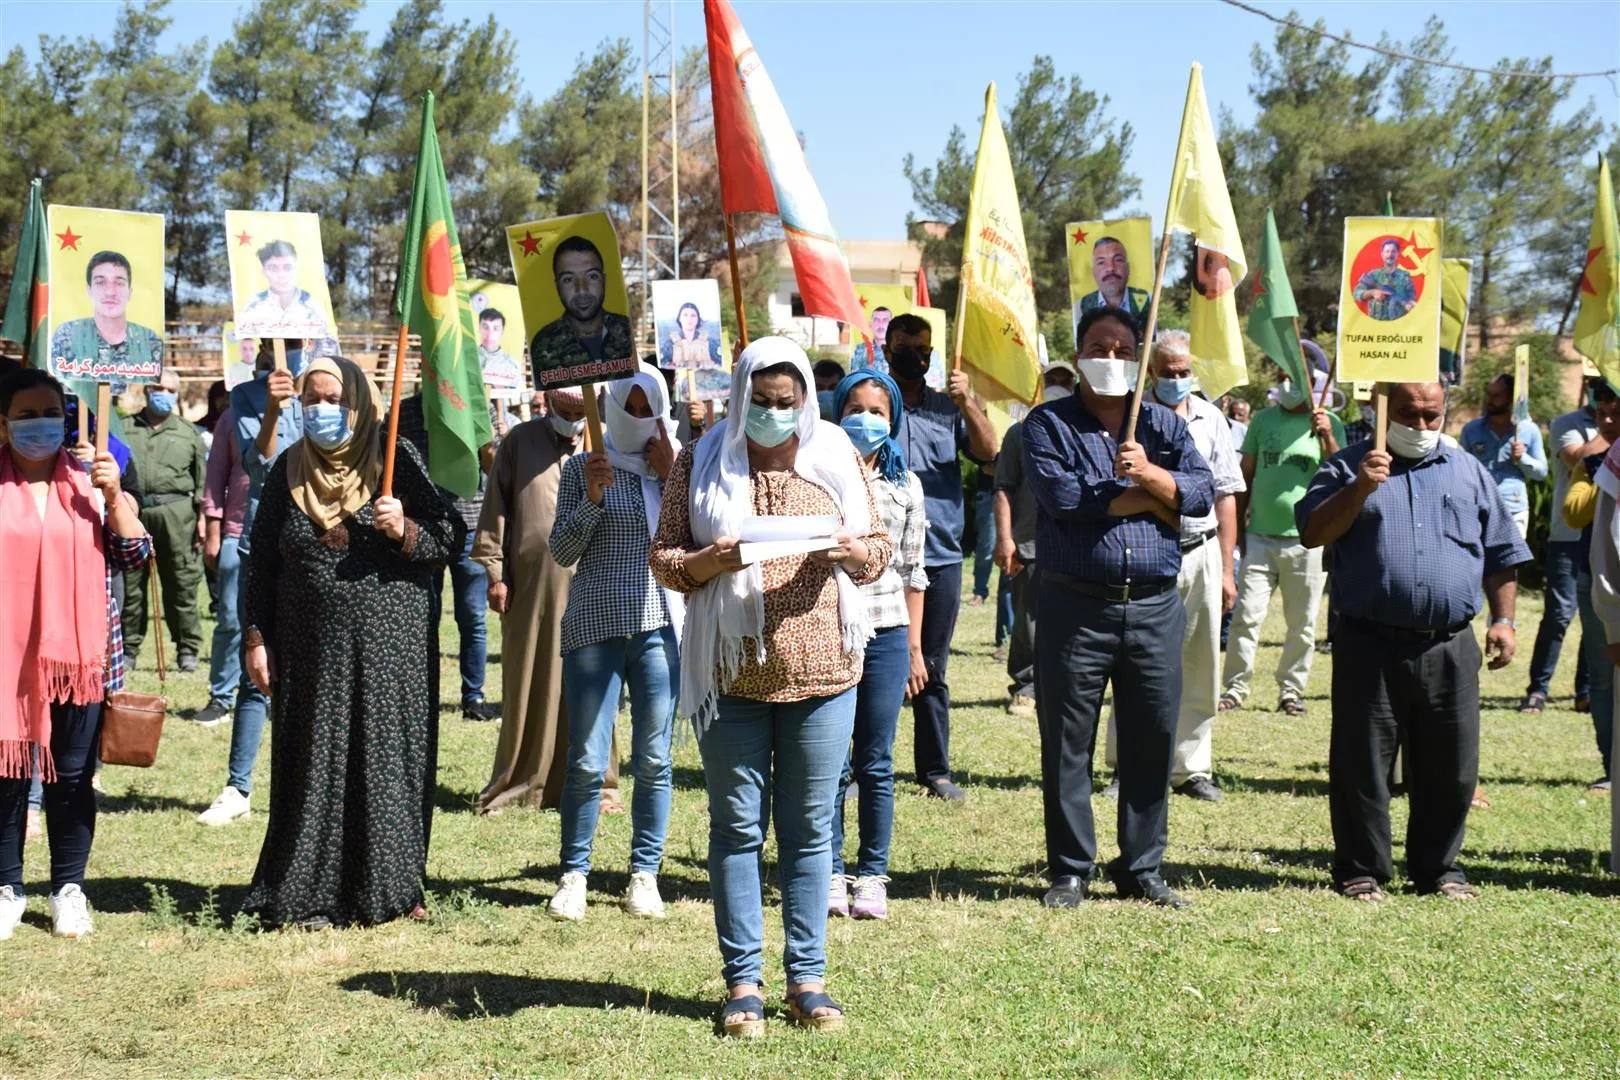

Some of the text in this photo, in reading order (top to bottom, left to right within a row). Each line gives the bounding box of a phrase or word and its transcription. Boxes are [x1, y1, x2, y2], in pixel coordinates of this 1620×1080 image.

[1345, 333, 1423, 344] TUFAN EROĞLUER
[1359, 349, 1407, 359] HASAN ALİ
[56, 357, 160, 378] الشهيد ممو كرامة
[570, 362, 604, 379] ESMER
